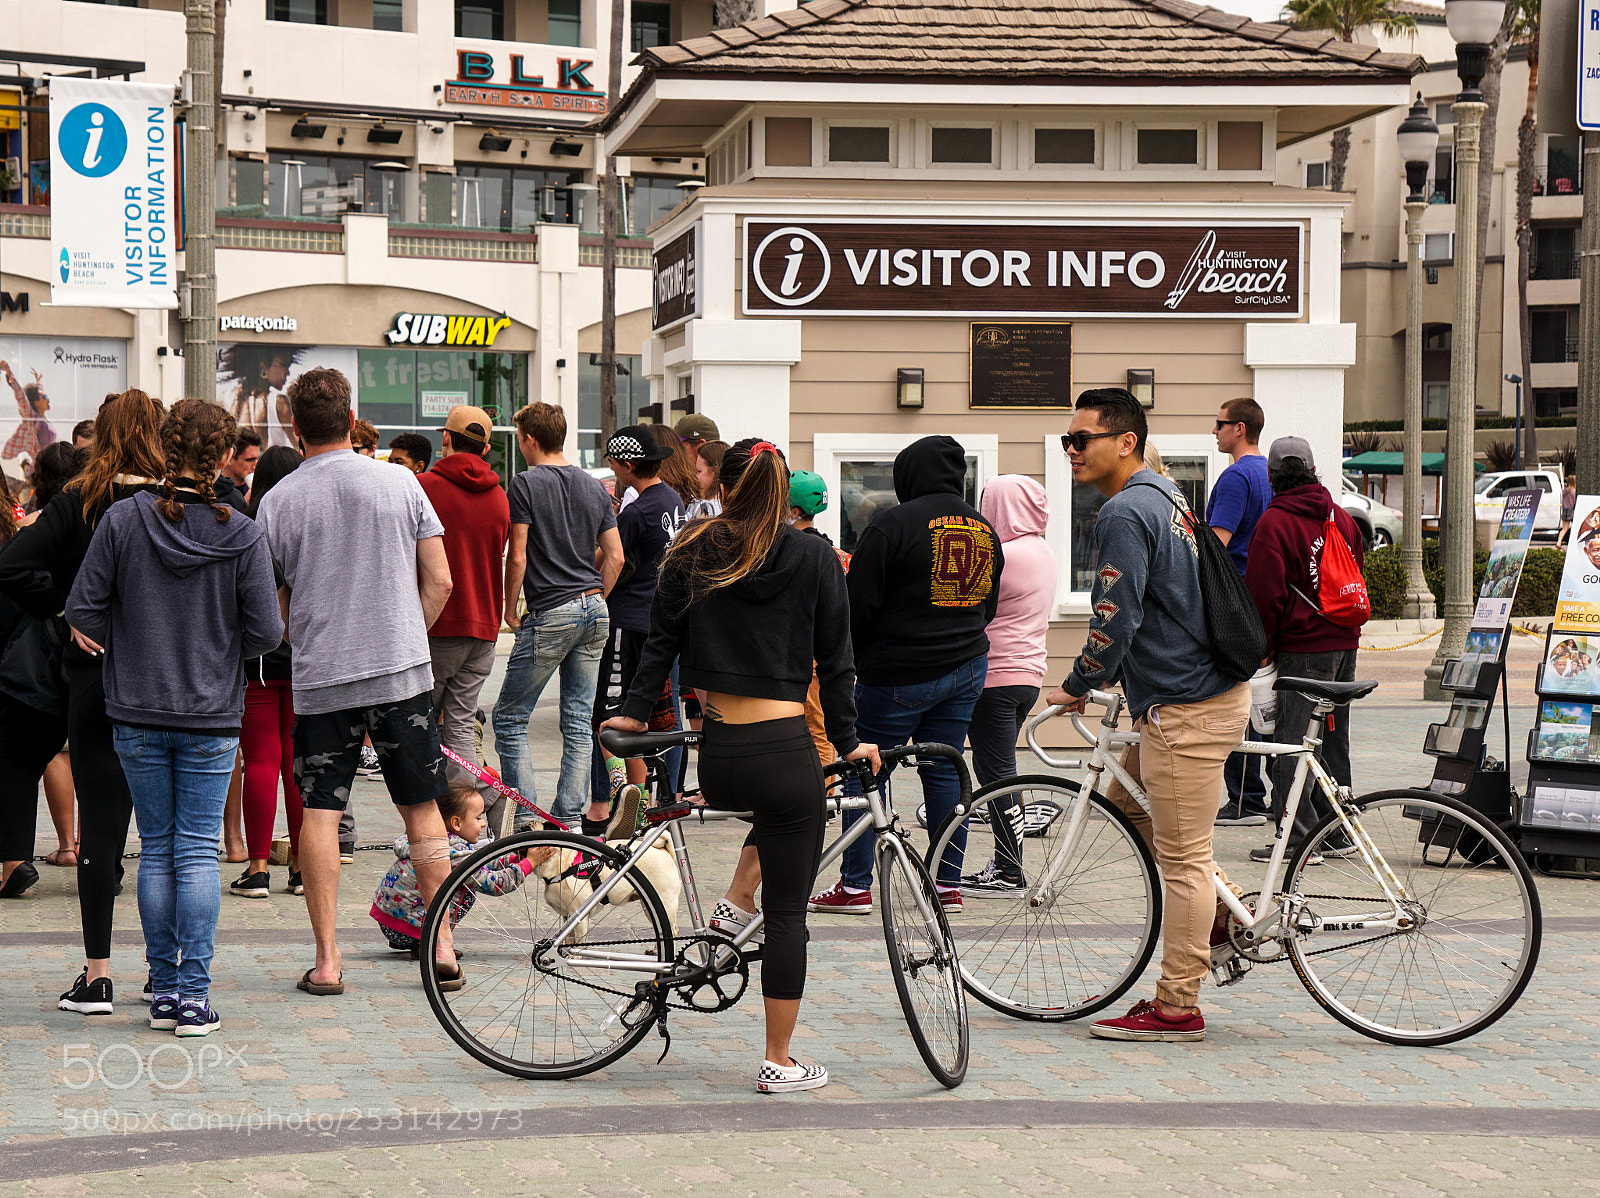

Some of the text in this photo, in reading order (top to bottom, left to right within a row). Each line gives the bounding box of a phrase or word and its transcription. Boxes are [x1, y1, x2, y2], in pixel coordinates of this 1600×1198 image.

[456, 49, 594, 91] BLK
[147, 106, 167, 286] INFORMATION
[124, 185, 144, 286] VISITOR
[73, 261, 115, 269] HUNTINGTON
[73, 270, 95, 278] BEACH
[843, 248, 1166, 288] VISITOR INFO
[1197, 258, 1278, 269] HUNTINGTON
[1197, 250, 1288, 293] beach
[220, 315, 298, 333] patagonia
[385, 312, 512, 347] SUBWAY
[65, 353, 117, 365] Hydro Flask
[385, 353, 470, 386] fresh
[425, 396, 465, 404] PARTY SUBS
[929, 515, 964, 529] OCEAN
[1560, 613, 1584, 622] FREE
[450, 753, 482, 777] SERVICE
[492, 780, 543, 815] SERVICE DOG
[679, 858, 700, 921] FUJI
